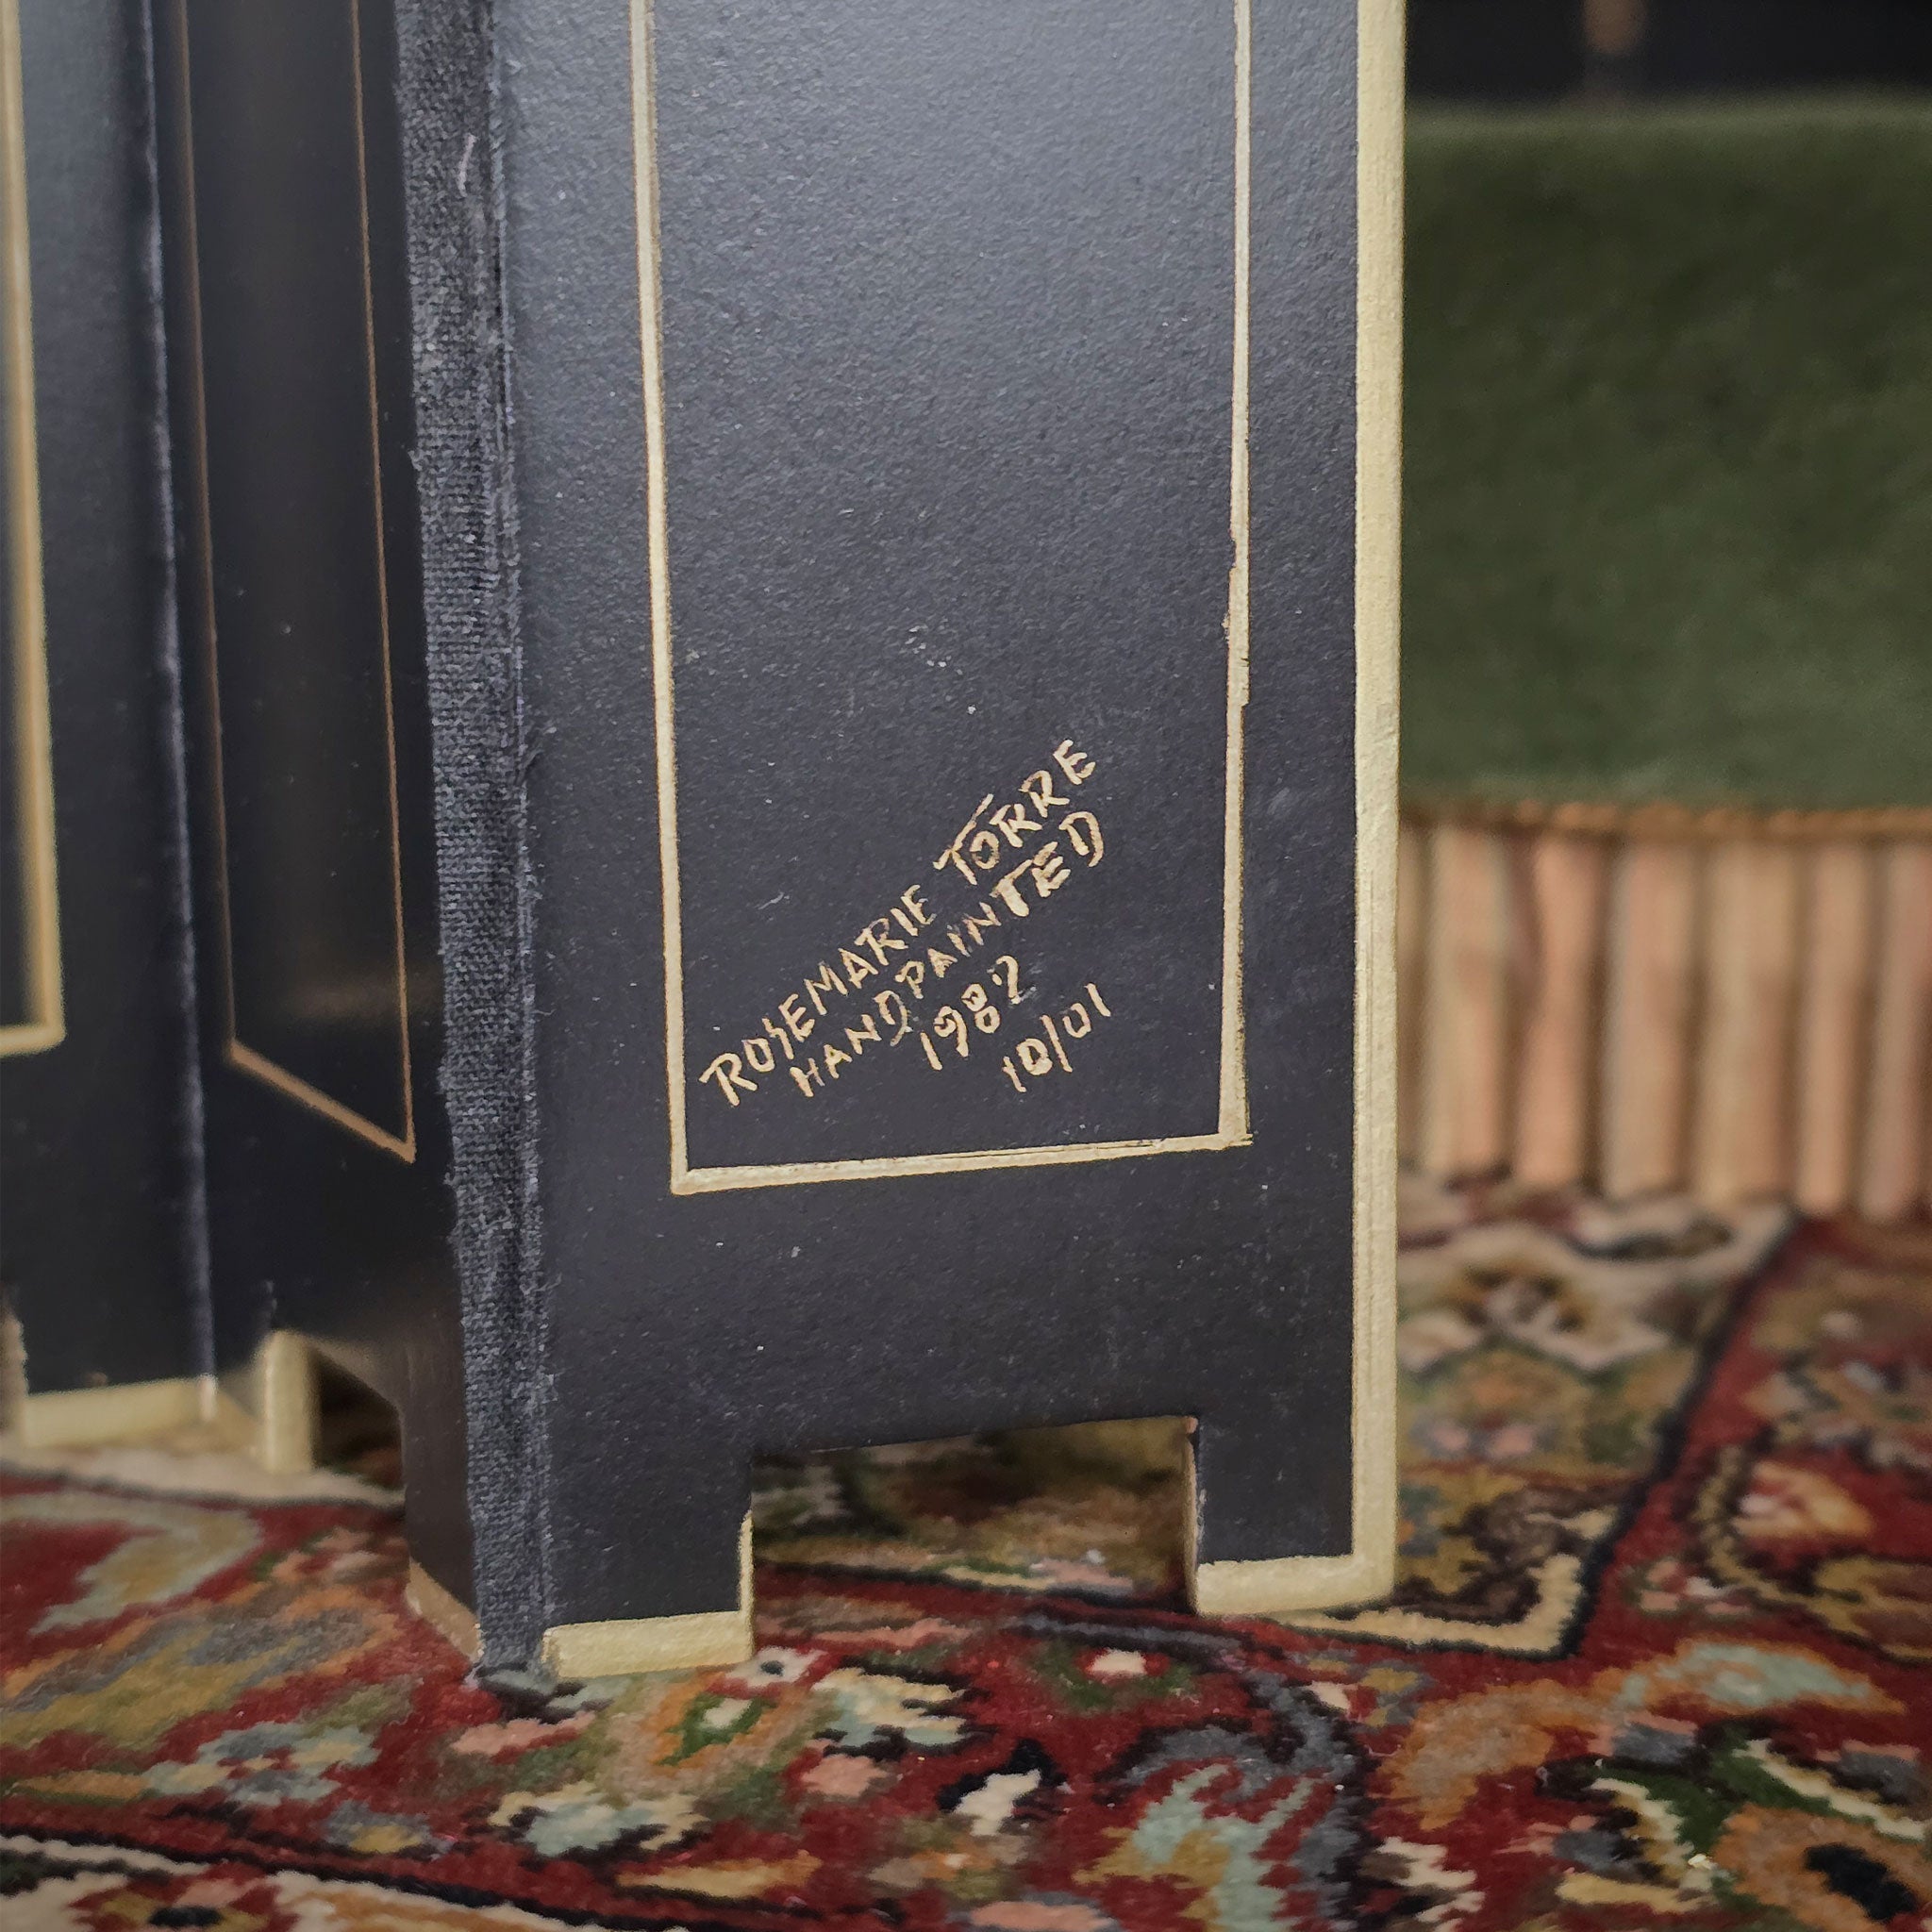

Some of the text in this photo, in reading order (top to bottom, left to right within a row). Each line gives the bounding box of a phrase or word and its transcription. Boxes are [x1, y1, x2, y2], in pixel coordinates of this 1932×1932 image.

[699, 739, 1096, 1106] ROSEMARIE TORRE
[920, 955, 1037, 1071] 1982
[1001, 983, 1111, 1092] 10/01
